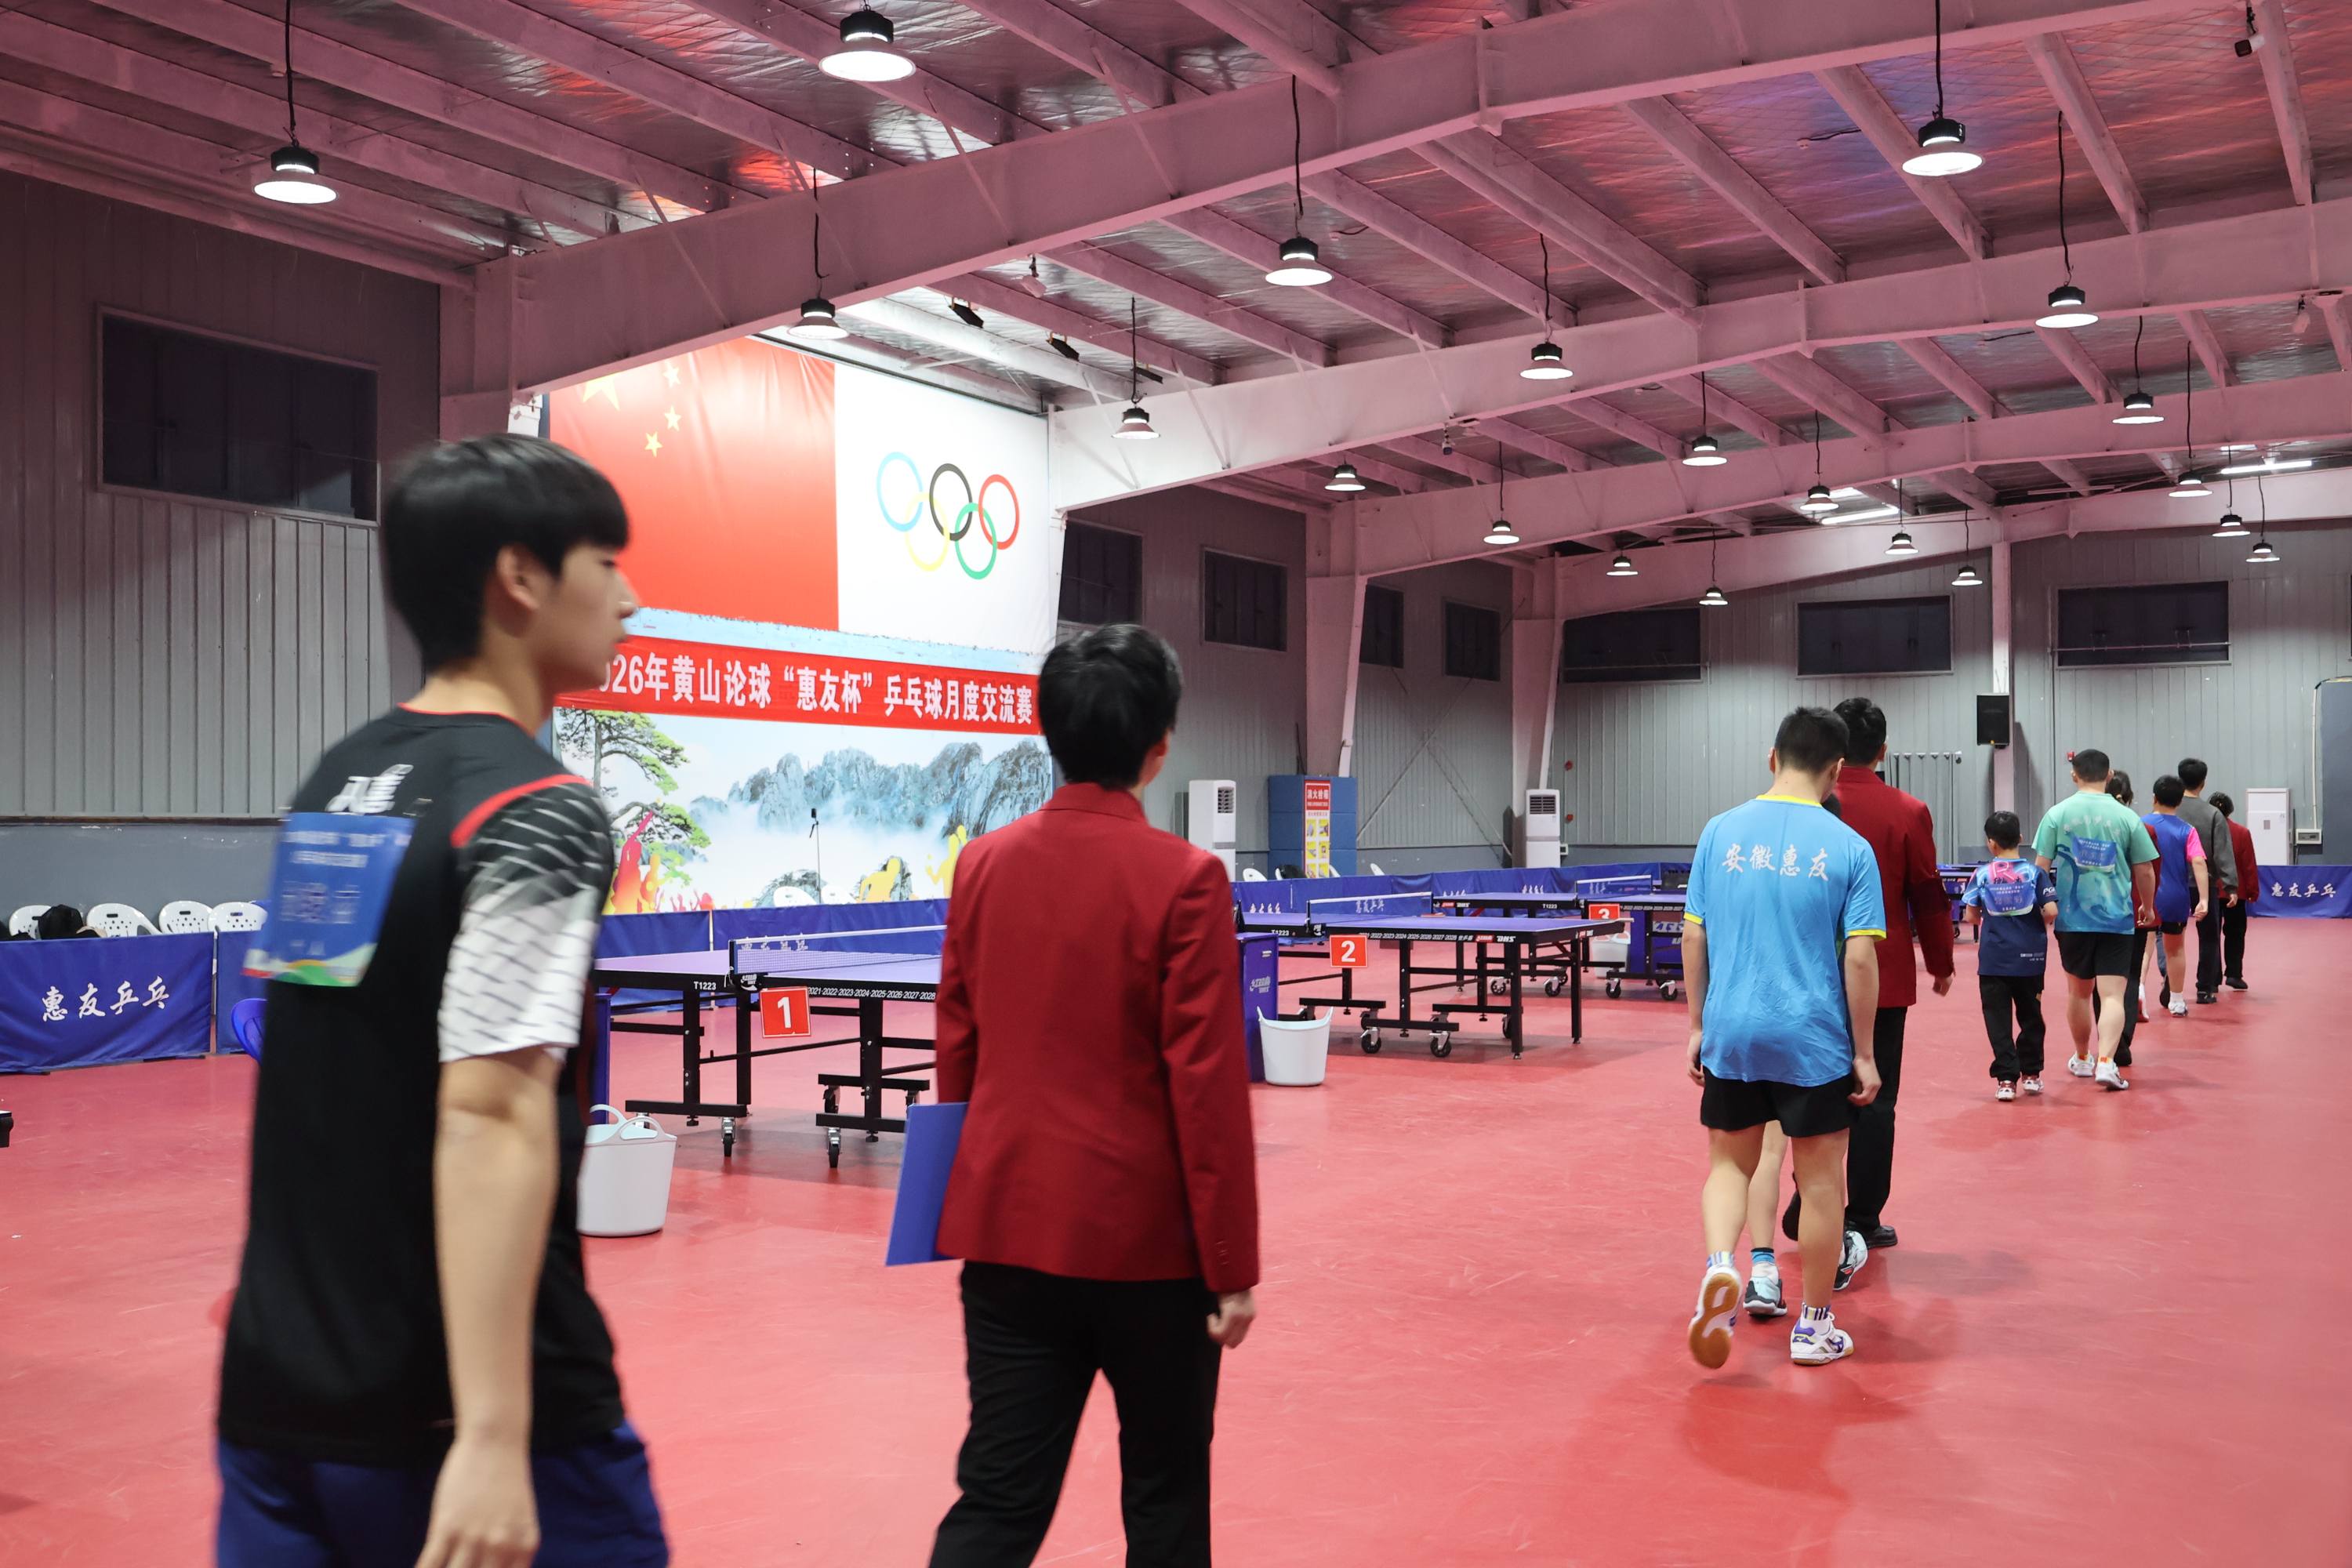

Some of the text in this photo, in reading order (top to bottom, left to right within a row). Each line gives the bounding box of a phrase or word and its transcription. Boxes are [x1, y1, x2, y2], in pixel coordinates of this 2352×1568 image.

[1722, 843, 1829, 881] 安徽惠友
[2270, 882, 2336, 898] 惠友乒乓
[1341, 939, 1356, 963] 2
[42, 975, 169, 1022] 惠友乒乓
[694, 981, 717, 991] T1223
[777, 996, 791, 1029] 1
